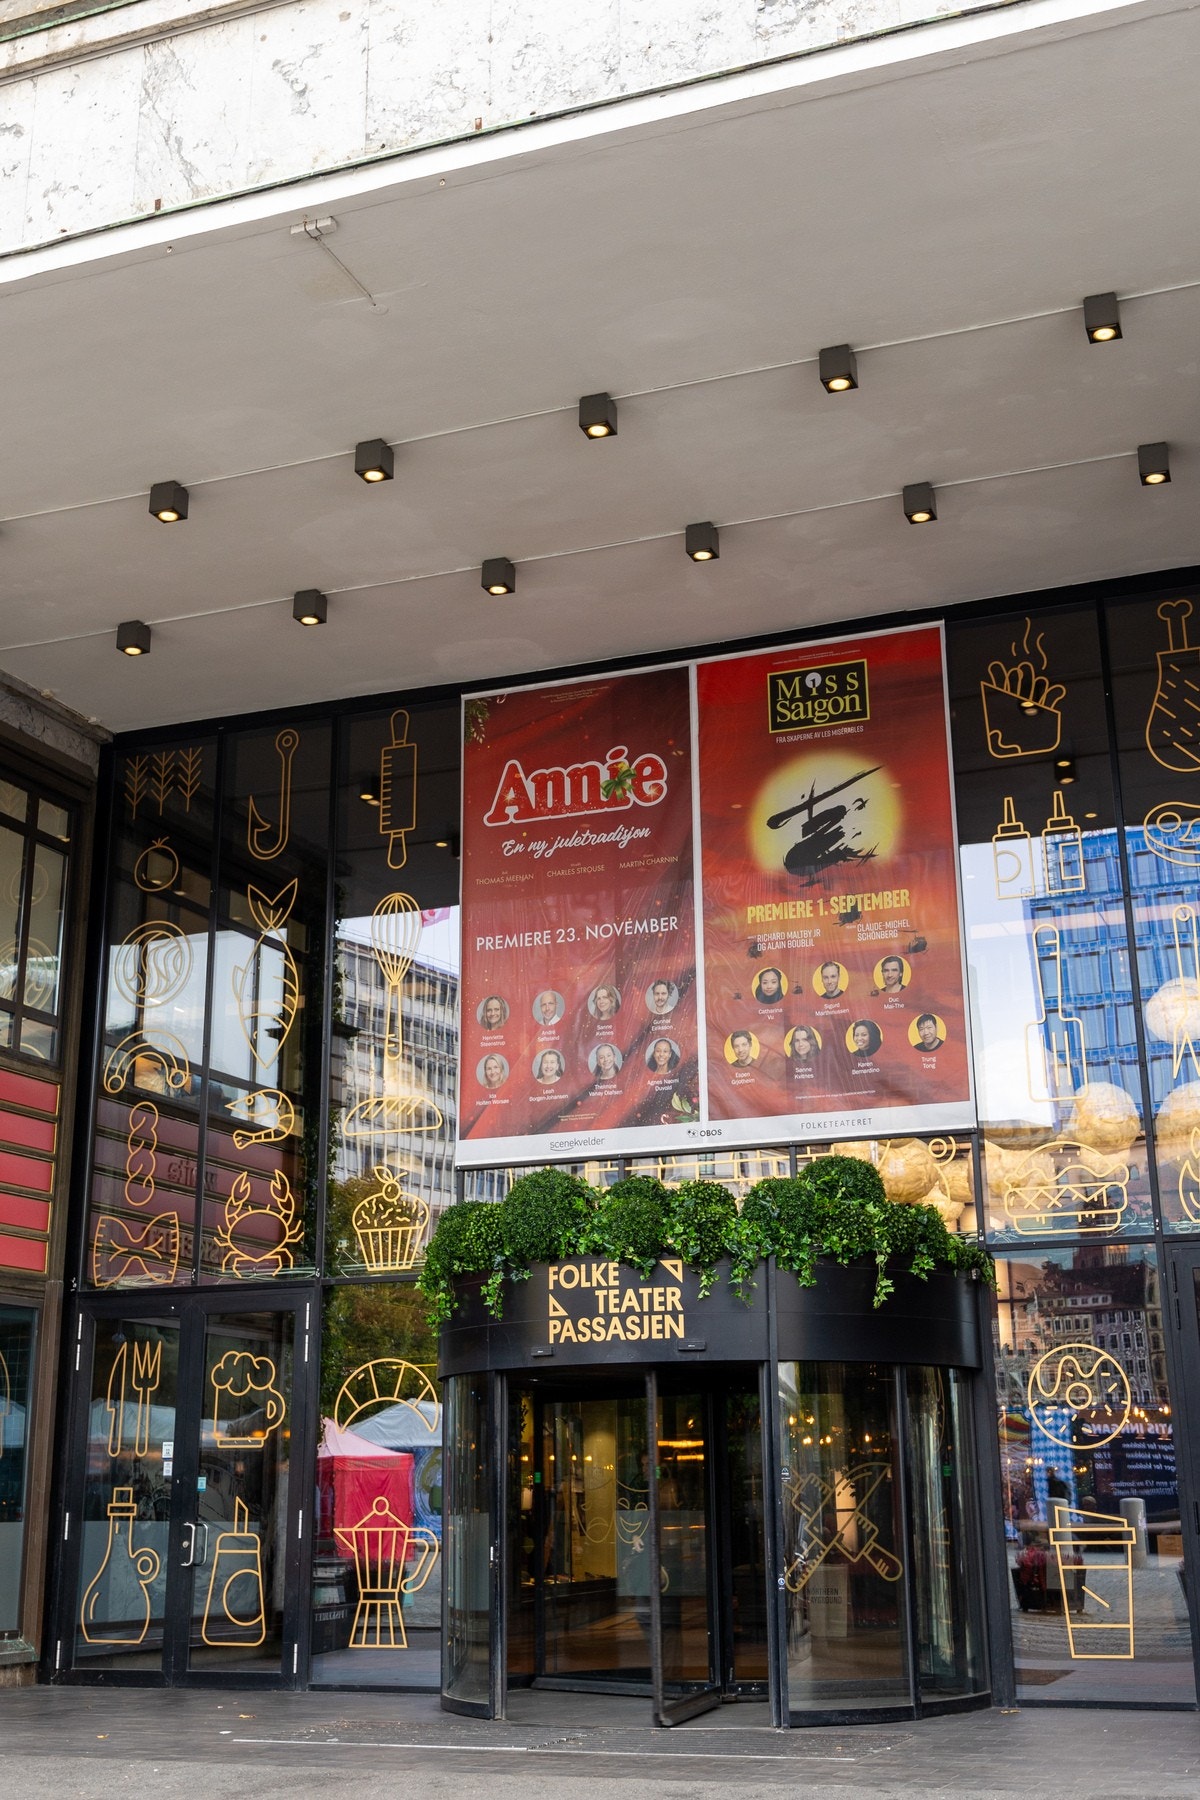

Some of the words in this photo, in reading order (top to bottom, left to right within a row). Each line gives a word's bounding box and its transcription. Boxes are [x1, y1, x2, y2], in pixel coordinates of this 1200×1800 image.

[776, 694, 862, 723] Saigon
[776, 736, 786, 744] FRA
[787, 733, 814, 742] SKAPERNE
[821, 730, 831, 738] LES
[832, 725, 864, 737] MISÉRABLES
[483, 746, 667, 827] Annie
[501, 839, 526, 856] En
[527, 839, 549, 858] ny
[544, 825, 651, 858] juletradisjon
[619, 860, 645, 869] MARTIN
[646, 856, 679, 865] CHARNIN
[546, 868, 575, 878] CHARLES
[576, 864, 605, 874] STROUSE
[476, 875, 505, 885] THOMAS
[505, 873, 534, 883] MEEHAN
[747, 899, 814, 924] PREMIERE
[817, 898, 829, 916] 1.
[830, 889, 911, 914] SEPTEMBER
[857, 919, 910, 932] CLAUDE-MICHEL
[476, 930, 551, 951] PREMIERE
[555, 926, 581, 943] 23.
[586, 916, 679, 941] NOVEMBER
[757, 933, 786, 943] RICHARD
[786, 930, 812, 940] MALTBY
[812, 928, 821, 938] JR
[757, 943, 767, 952] OG
[767, 941, 787, 951] ALAIN
[787, 939, 815, 949] BOUBLIL
[758, 1007, 783, 1015] Catharina
[823, 1002, 840, 1010] Sigurd
[852, 1067, 880, 1076] Bernardino
[923, 1062, 936, 1070] Tong
[800, 1117, 872, 1130] FOLKETEATERET
[700, 1129, 722, 1137] OBOS
[550, 1137, 605, 1149] scenekvelder
[549, 1262, 619, 1290] FOLKE
[595, 1287, 684, 1314] TEATER
[549, 1314, 685, 1344] PASSASJEN
